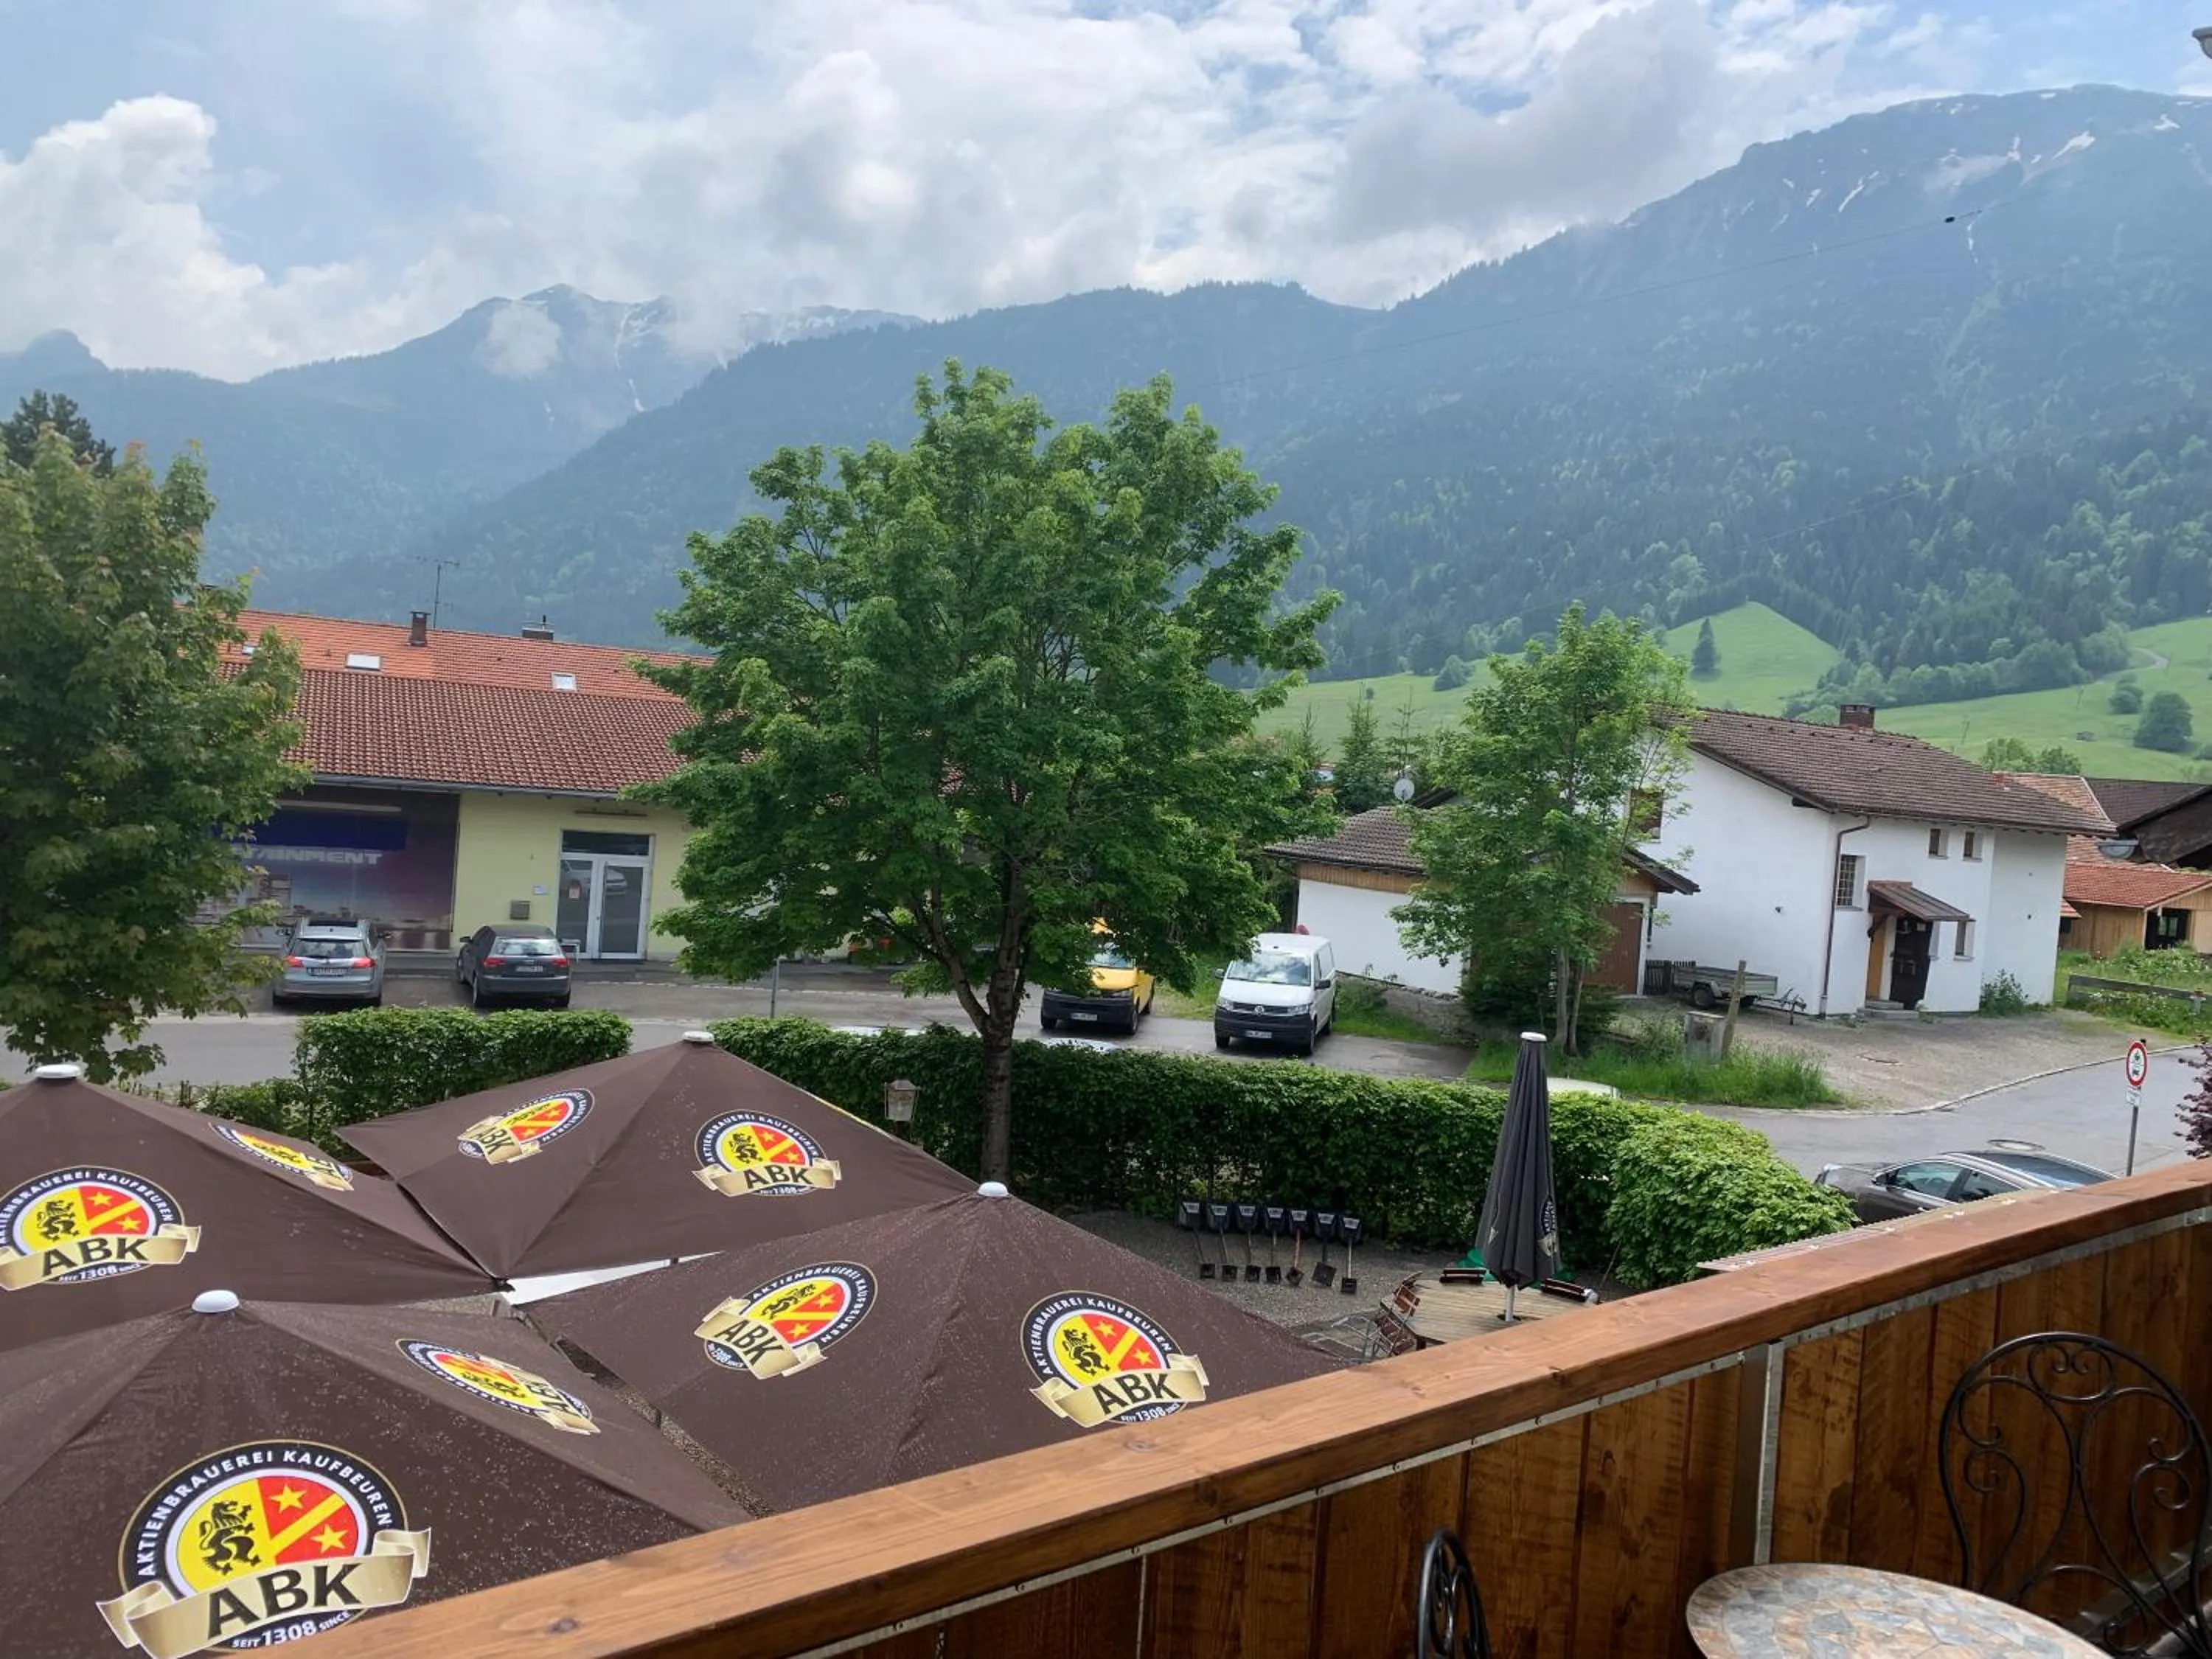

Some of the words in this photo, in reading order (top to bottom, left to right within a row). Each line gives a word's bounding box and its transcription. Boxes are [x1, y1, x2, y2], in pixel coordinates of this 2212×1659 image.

[469, 1126, 515, 1155] BK
[742, 1164, 813, 1189] ABK
[41, 1237, 147, 1277] ABK
[714, 1319, 784, 1365] ABK
[1030, 1296, 1082, 1374] AKTIENBRAUEREI
[1087, 1298, 1172, 1351] KAUFBEUREN
[1092, 1374, 1181, 1415] ABK
[1135, 1406, 1166, 1422] 1308
[137, 1450, 273, 1576] AKTIENBRAUEREI
[283, 1450, 394, 1526] KAUFBEUREN
[207, 1563, 362, 1641] ABK
[232, 1637, 260, 1648] SEIT
[262, 1620, 317, 1646] 1308
